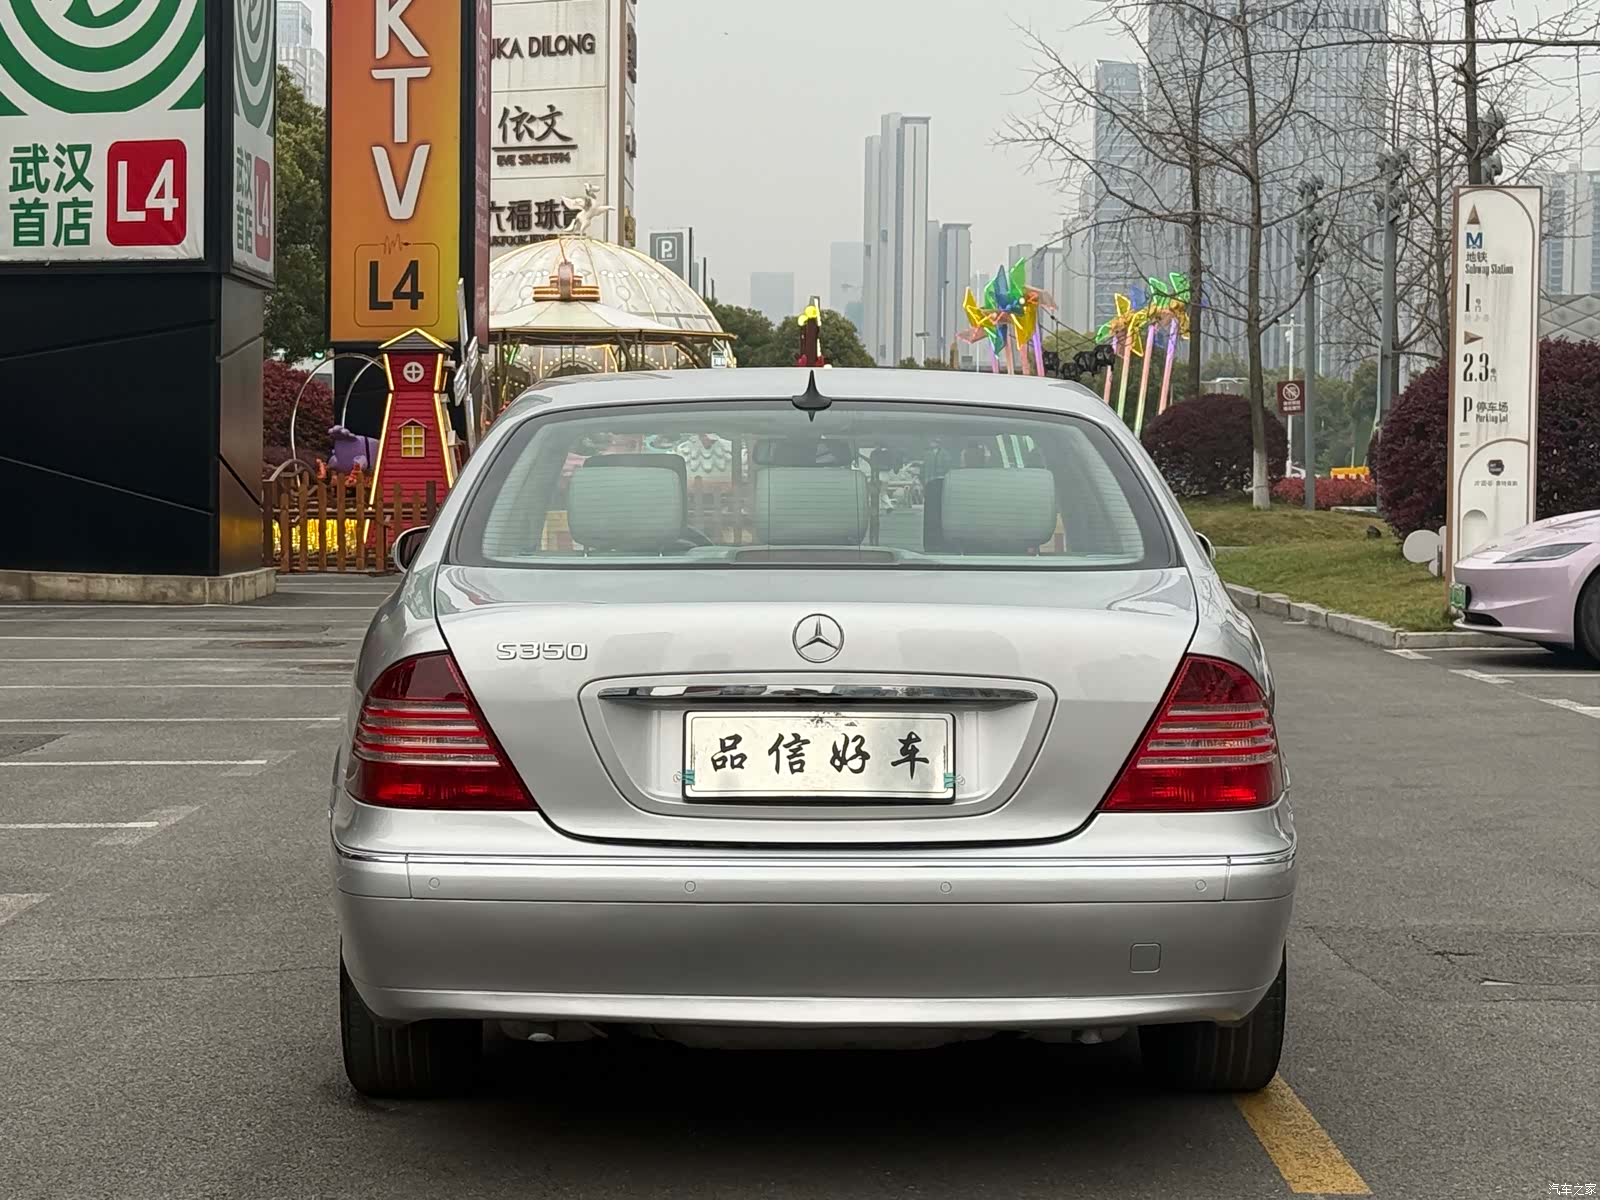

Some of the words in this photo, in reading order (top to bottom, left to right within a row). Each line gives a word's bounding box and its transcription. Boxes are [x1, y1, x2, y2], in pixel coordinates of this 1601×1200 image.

[528, 33, 596, 58] DILONG
[498, 104, 573, 144] 依文
[9, 143, 94, 194] 武汉
[117, 159, 179, 222] L4
[9, 197, 93, 247] 首店
[369, 259, 424, 311] L4
[1463, 396, 1473, 423] P
[1476, 401, 1509, 413] 停车场
[496, 641, 588, 660] S350
[711, 731, 929, 780] 品信好车
